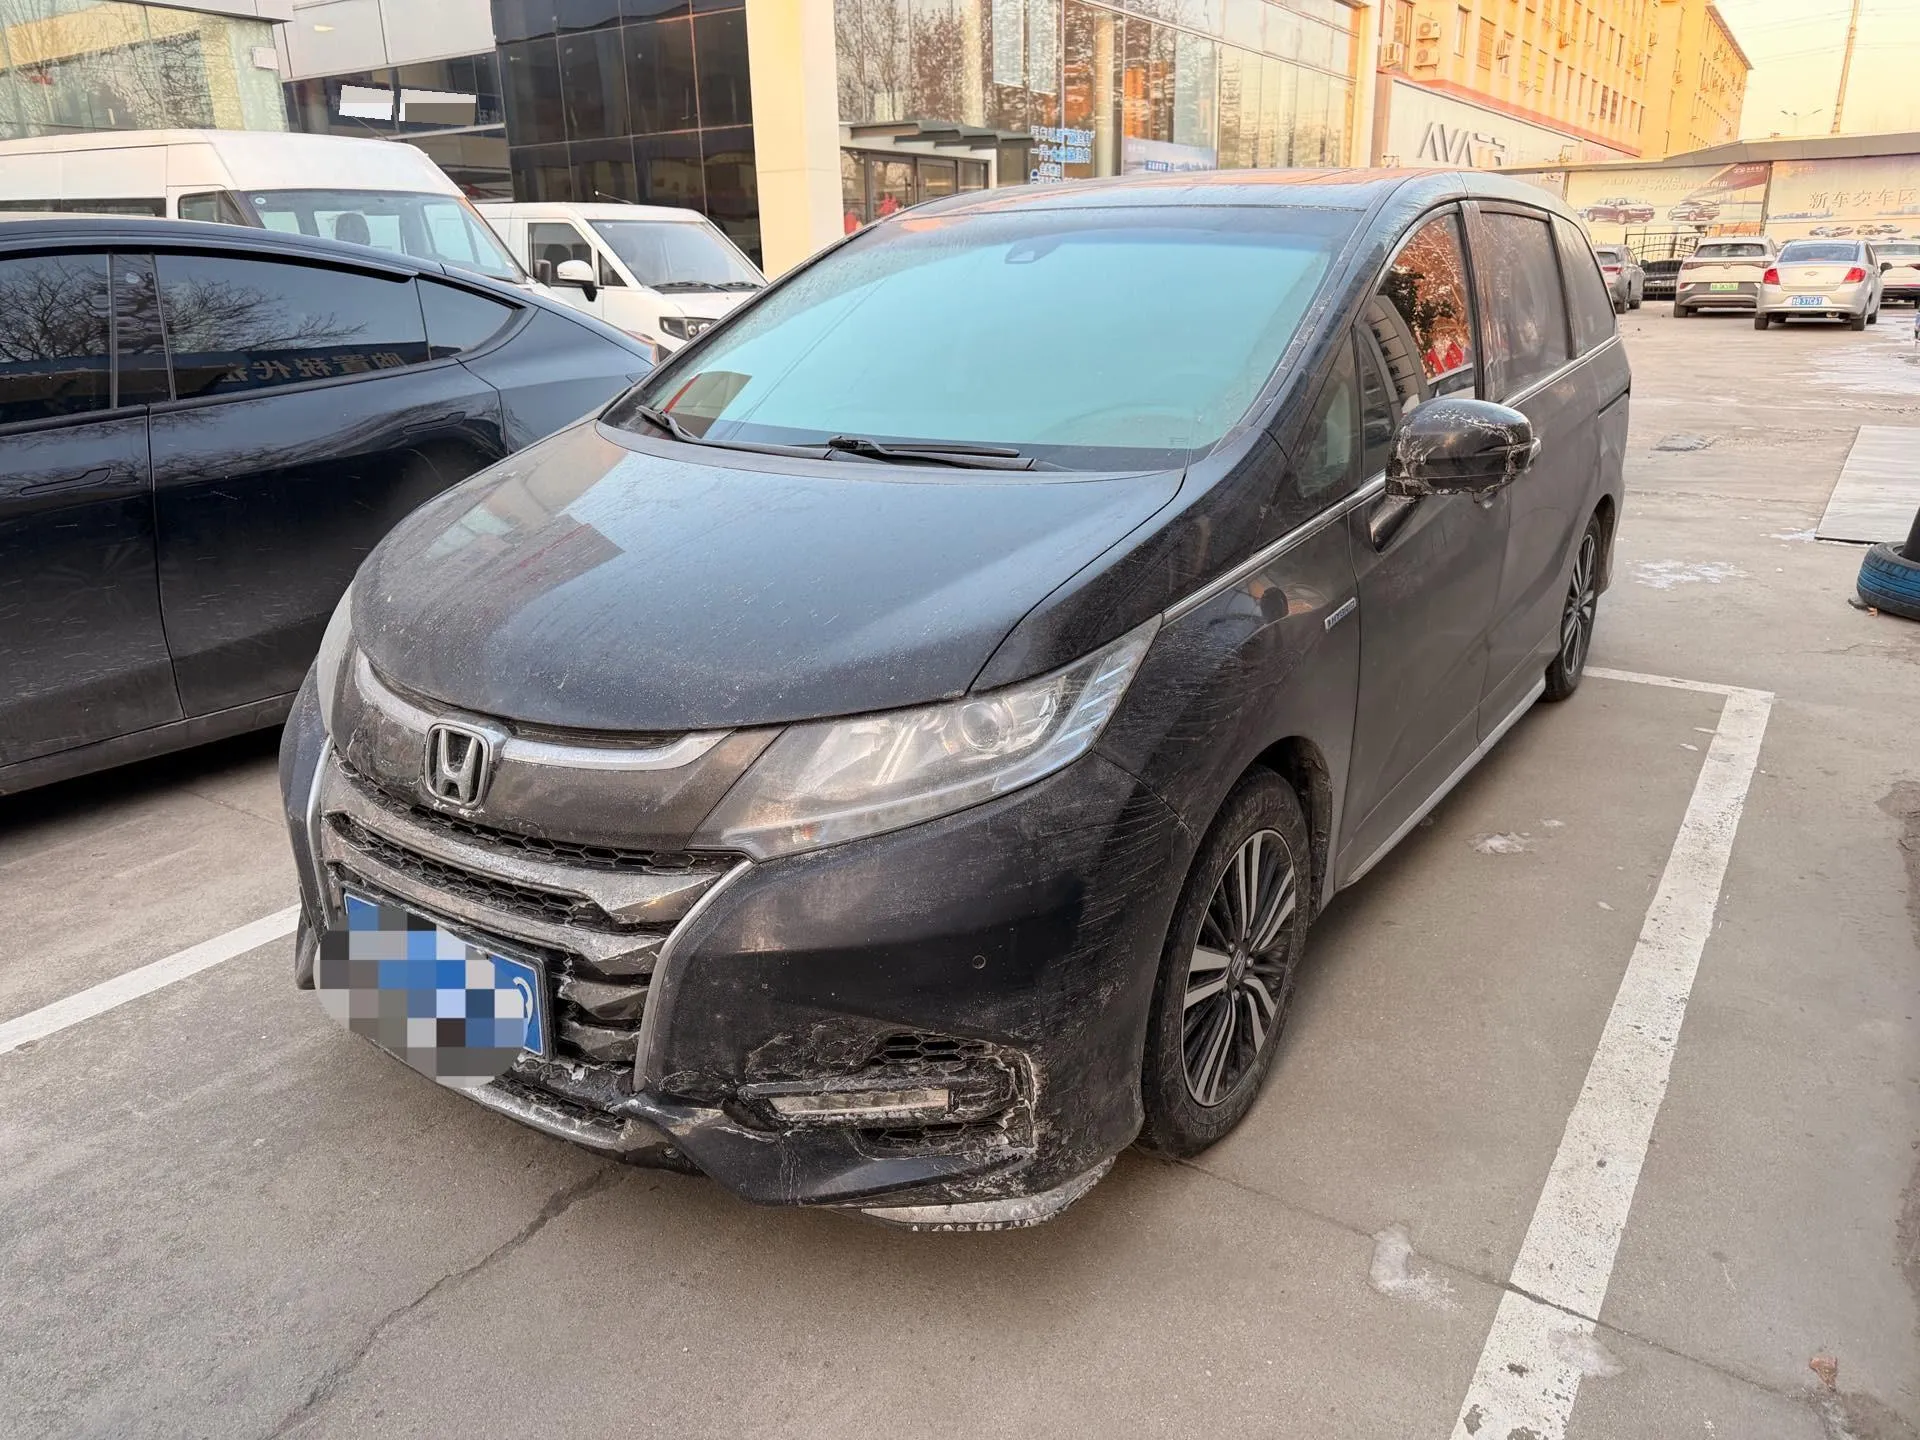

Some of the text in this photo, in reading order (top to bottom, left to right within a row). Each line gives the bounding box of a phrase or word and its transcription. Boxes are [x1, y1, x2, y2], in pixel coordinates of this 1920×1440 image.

[1809, 186, 1917, 209] 新车交车区
